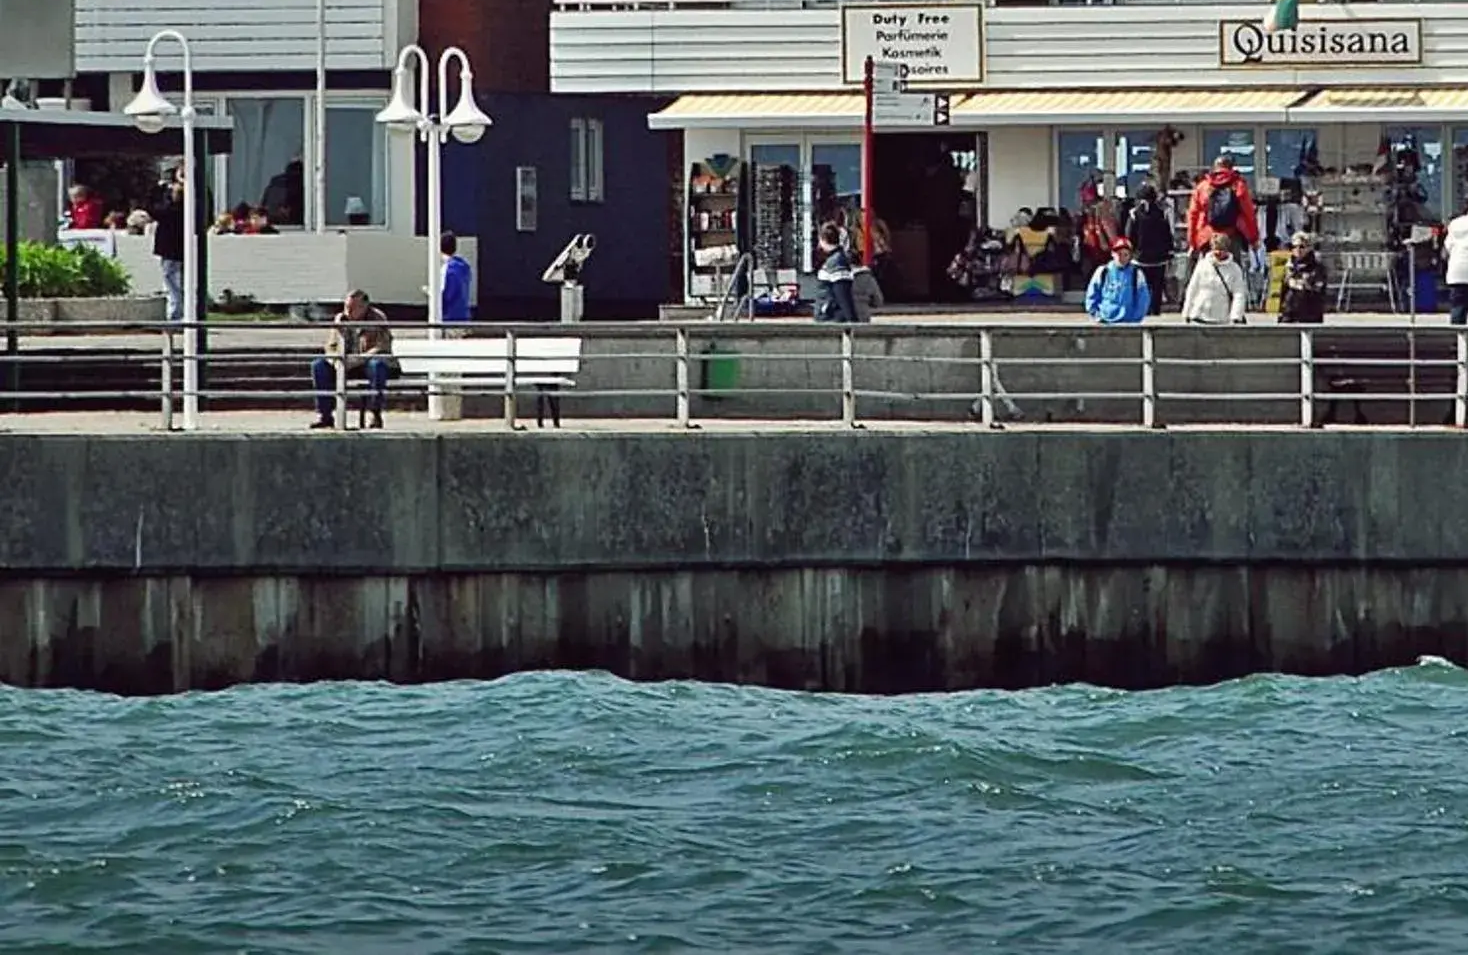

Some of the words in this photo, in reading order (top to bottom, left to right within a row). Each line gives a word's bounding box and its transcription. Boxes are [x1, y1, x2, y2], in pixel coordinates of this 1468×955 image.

[873, 14, 906, 26] Duty
[918, 13, 949, 24] Free
[1233, 21, 1409, 62] Quisisana
[882, 47, 941, 58] Kosmetik
